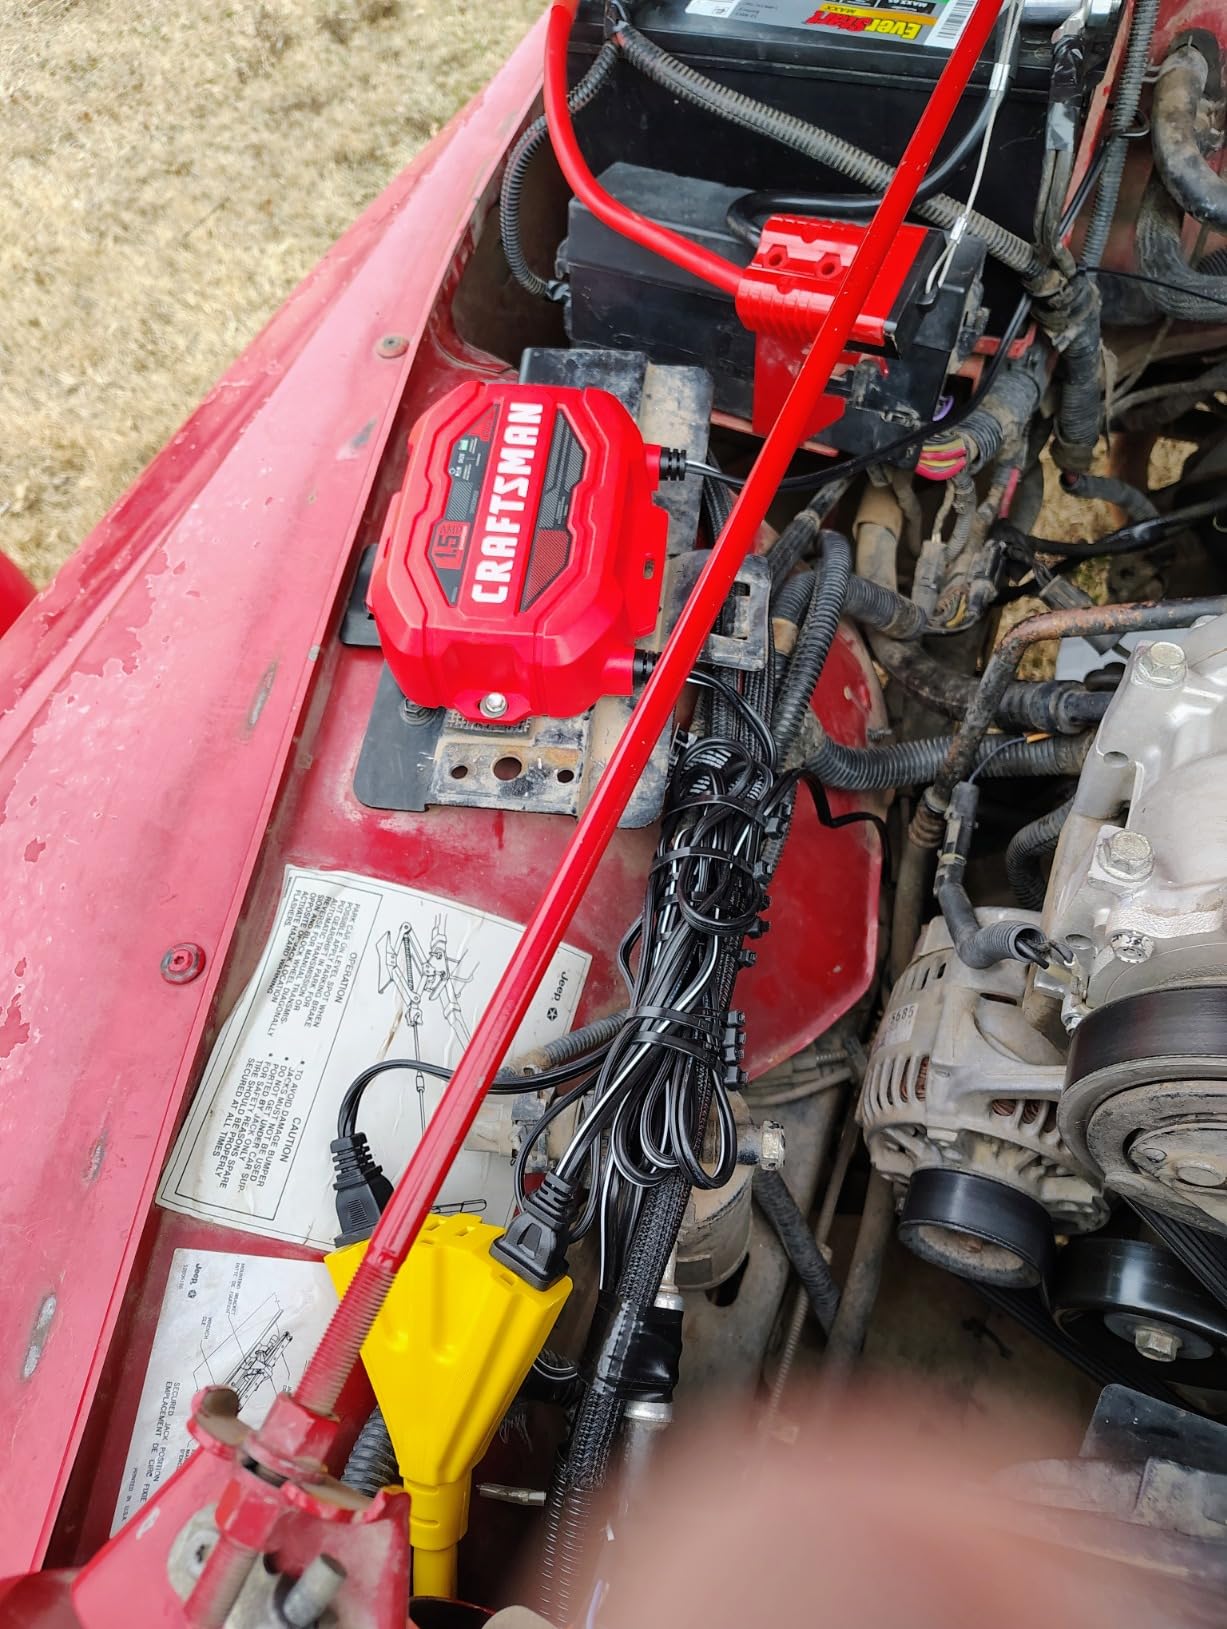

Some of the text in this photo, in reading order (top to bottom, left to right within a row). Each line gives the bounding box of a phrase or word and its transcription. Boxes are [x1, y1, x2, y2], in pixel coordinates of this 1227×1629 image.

[804, 10, 922, 40] EverStart
[824, 5, 856, 13] MAXX
[471, 402, 543, 604] CRAFTSMAN
[434, 535, 460, 557] 1.5
[299, 892, 316, 927] OPPOSITE
[336, 900, 345, 913] PUT
[267, 891, 308, 994] ACTIVATE HAZARD WARNING
[281, 896, 331, 1024] REVERSE FOR MANUAL TRANSMIS-
[287, 941, 298, 962] JACK
[294, 898, 337, 1011] AUTOMATIC TRANSMISSION OR
[322, 916, 340, 956] GEARSHIFT
[268, 894, 324, 1036] SION AND BLOCK WHEEL DIAGONALLY
[272, 964, 290, 1003] LOCATION
[305, 902, 352, 1028] POSSIBLE APPLY PARKING BRAKE
[310, 968, 322, 988] PARK
[314, 903, 360, 1027] PARK CAR ON LEVEL SPOT WHEN
[335, 952, 358, 1003] OPERATION
[553, 971, 568, 1001] Jeep
[304, 991, 314, 1007] FOR
[213, 1058, 254, 1157] SECURED AT ALL TIMES
[215, 1059, 262, 1177] TIRE SHOULD BE PROPERLY
[220, 1061, 270, 1189] FOR SAFETY REASONS SPARE
[236, 1065, 287, 1193] DO NOT GET UNDER CAR SUP-
[239, 1063, 278, 1161] PORTED BY JACK ONLY
[250, 1067, 295, 1182] JACKS MUST NOT BE USED
[257, 1069, 303, 1187] TO AVOID DAMAGE BUMPER
[280, 1117, 301, 1162] CAUTION
[192, 1263, 202, 1283] Jeep
[153, 1382, 180, 1482] SECURED JACK POSITION
[155, 1381, 172, 1437] EMPLACEMENT
[152, 1443, 158, 1453] DE
